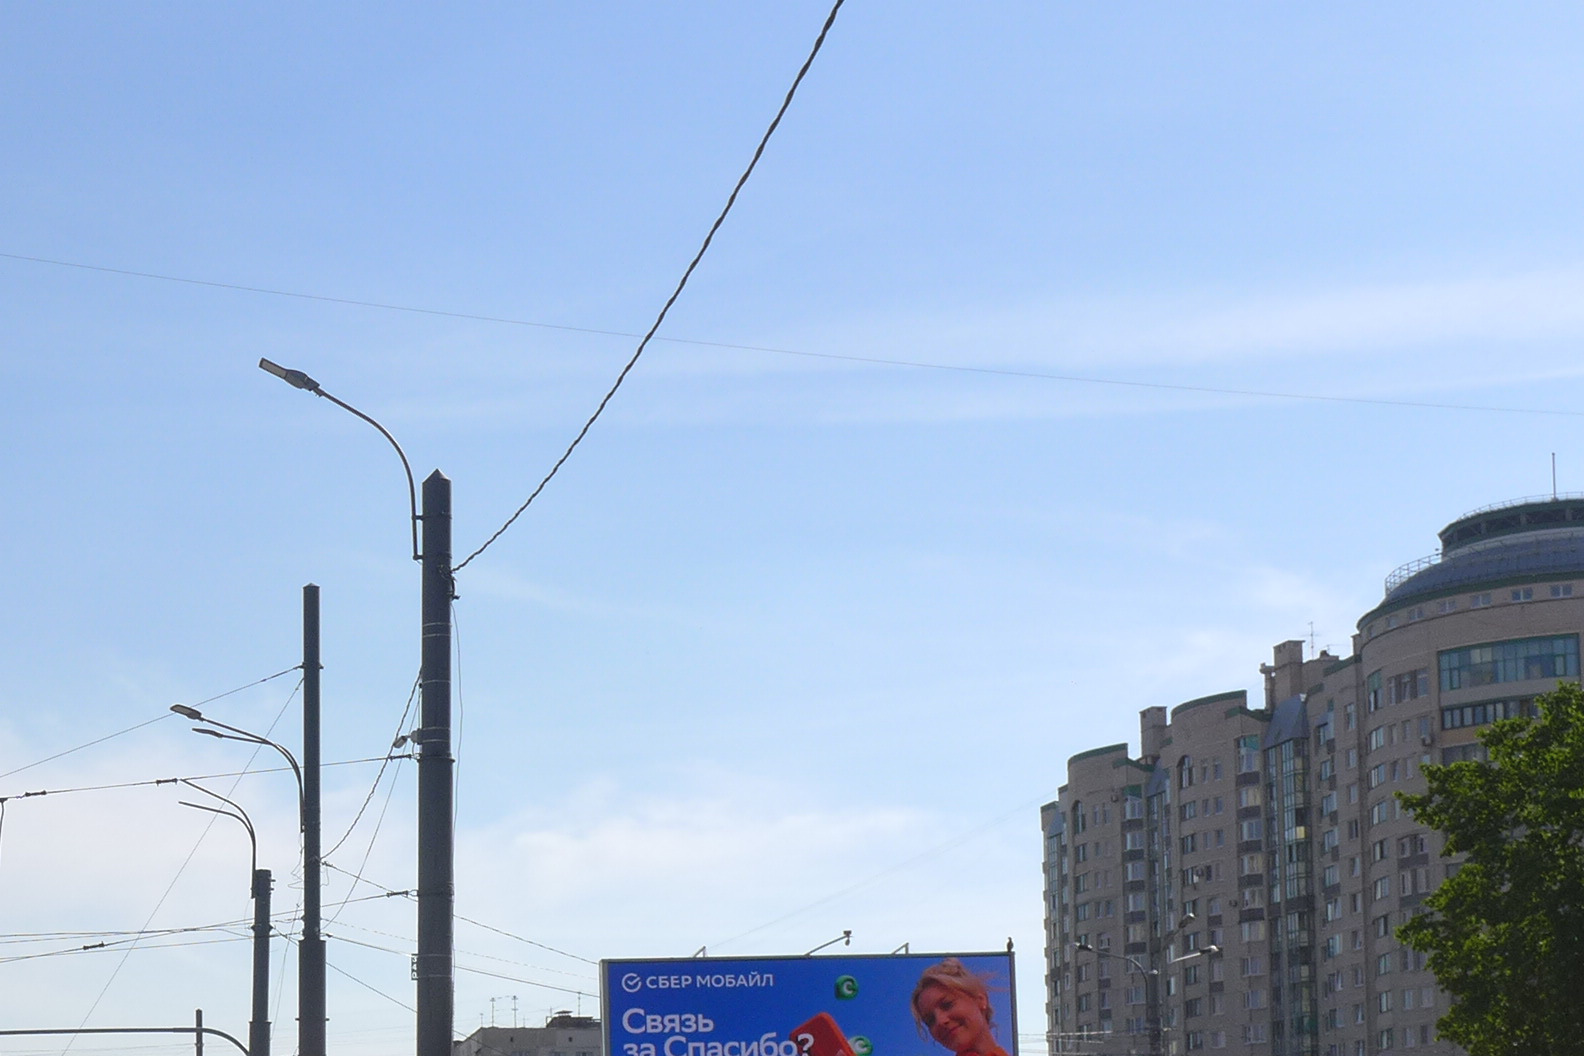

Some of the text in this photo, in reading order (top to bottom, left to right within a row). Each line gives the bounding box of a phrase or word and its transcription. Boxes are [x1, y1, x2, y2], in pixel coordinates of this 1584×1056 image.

[646, 972, 774, 988] СБЕР МОБАЙЛ
[622, 1008, 714, 1034] Связь
